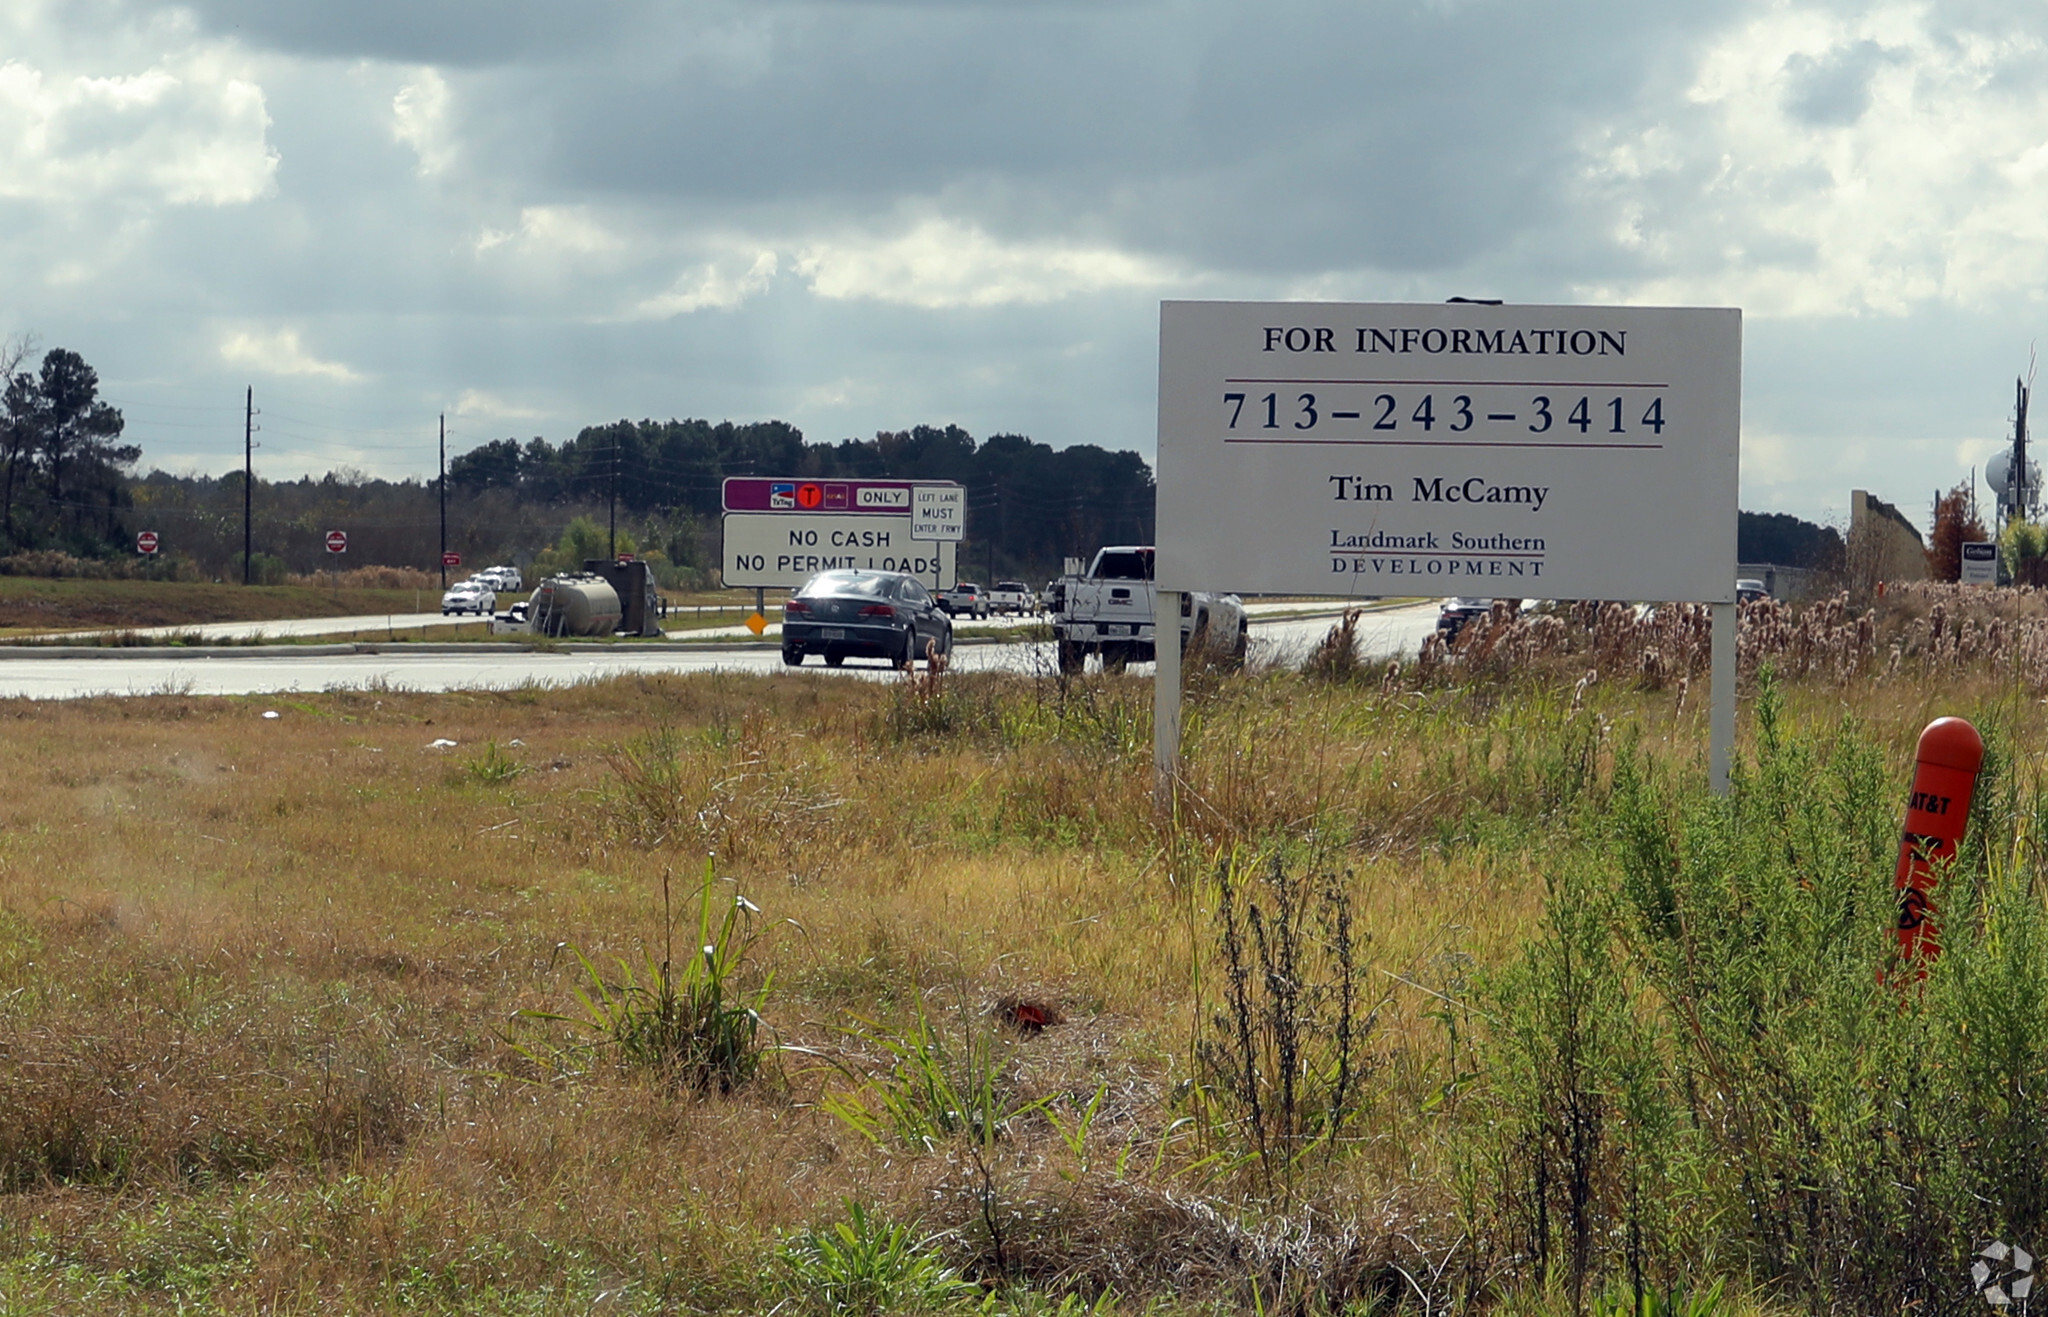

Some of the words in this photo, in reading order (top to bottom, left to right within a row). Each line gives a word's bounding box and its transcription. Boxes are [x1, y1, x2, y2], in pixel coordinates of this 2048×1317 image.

[1263, 327, 1336, 353] FOR
[1354, 328, 1627, 356] INFORMATION
[1223, 392, 1666, 434] 713-243-3414
[804, 487, 815, 505] T
[863, 491, 902, 504] ONLY
[918, 493, 935, 502] LEFT
[940, 494, 959, 503] LANE
[1329, 476, 1393, 502] Tim
[1412, 477, 1549, 511] McCamy
[922, 508, 954, 519] MUST
[914, 523, 937, 533] ENTER
[941, 524, 961, 534] FRWY
[789, 530, 818, 547] NO
[831, 531, 890, 548] CASH
[1331, 529, 1439, 550] Landmark
[1451, 531, 1546, 551] Southern
[736, 555, 765, 571] NO
[778, 556, 855, 572] PERMIT
[1332, 557, 1546, 577] DEVELOPMENT
[1910, 792, 1952, 815] AT&T
